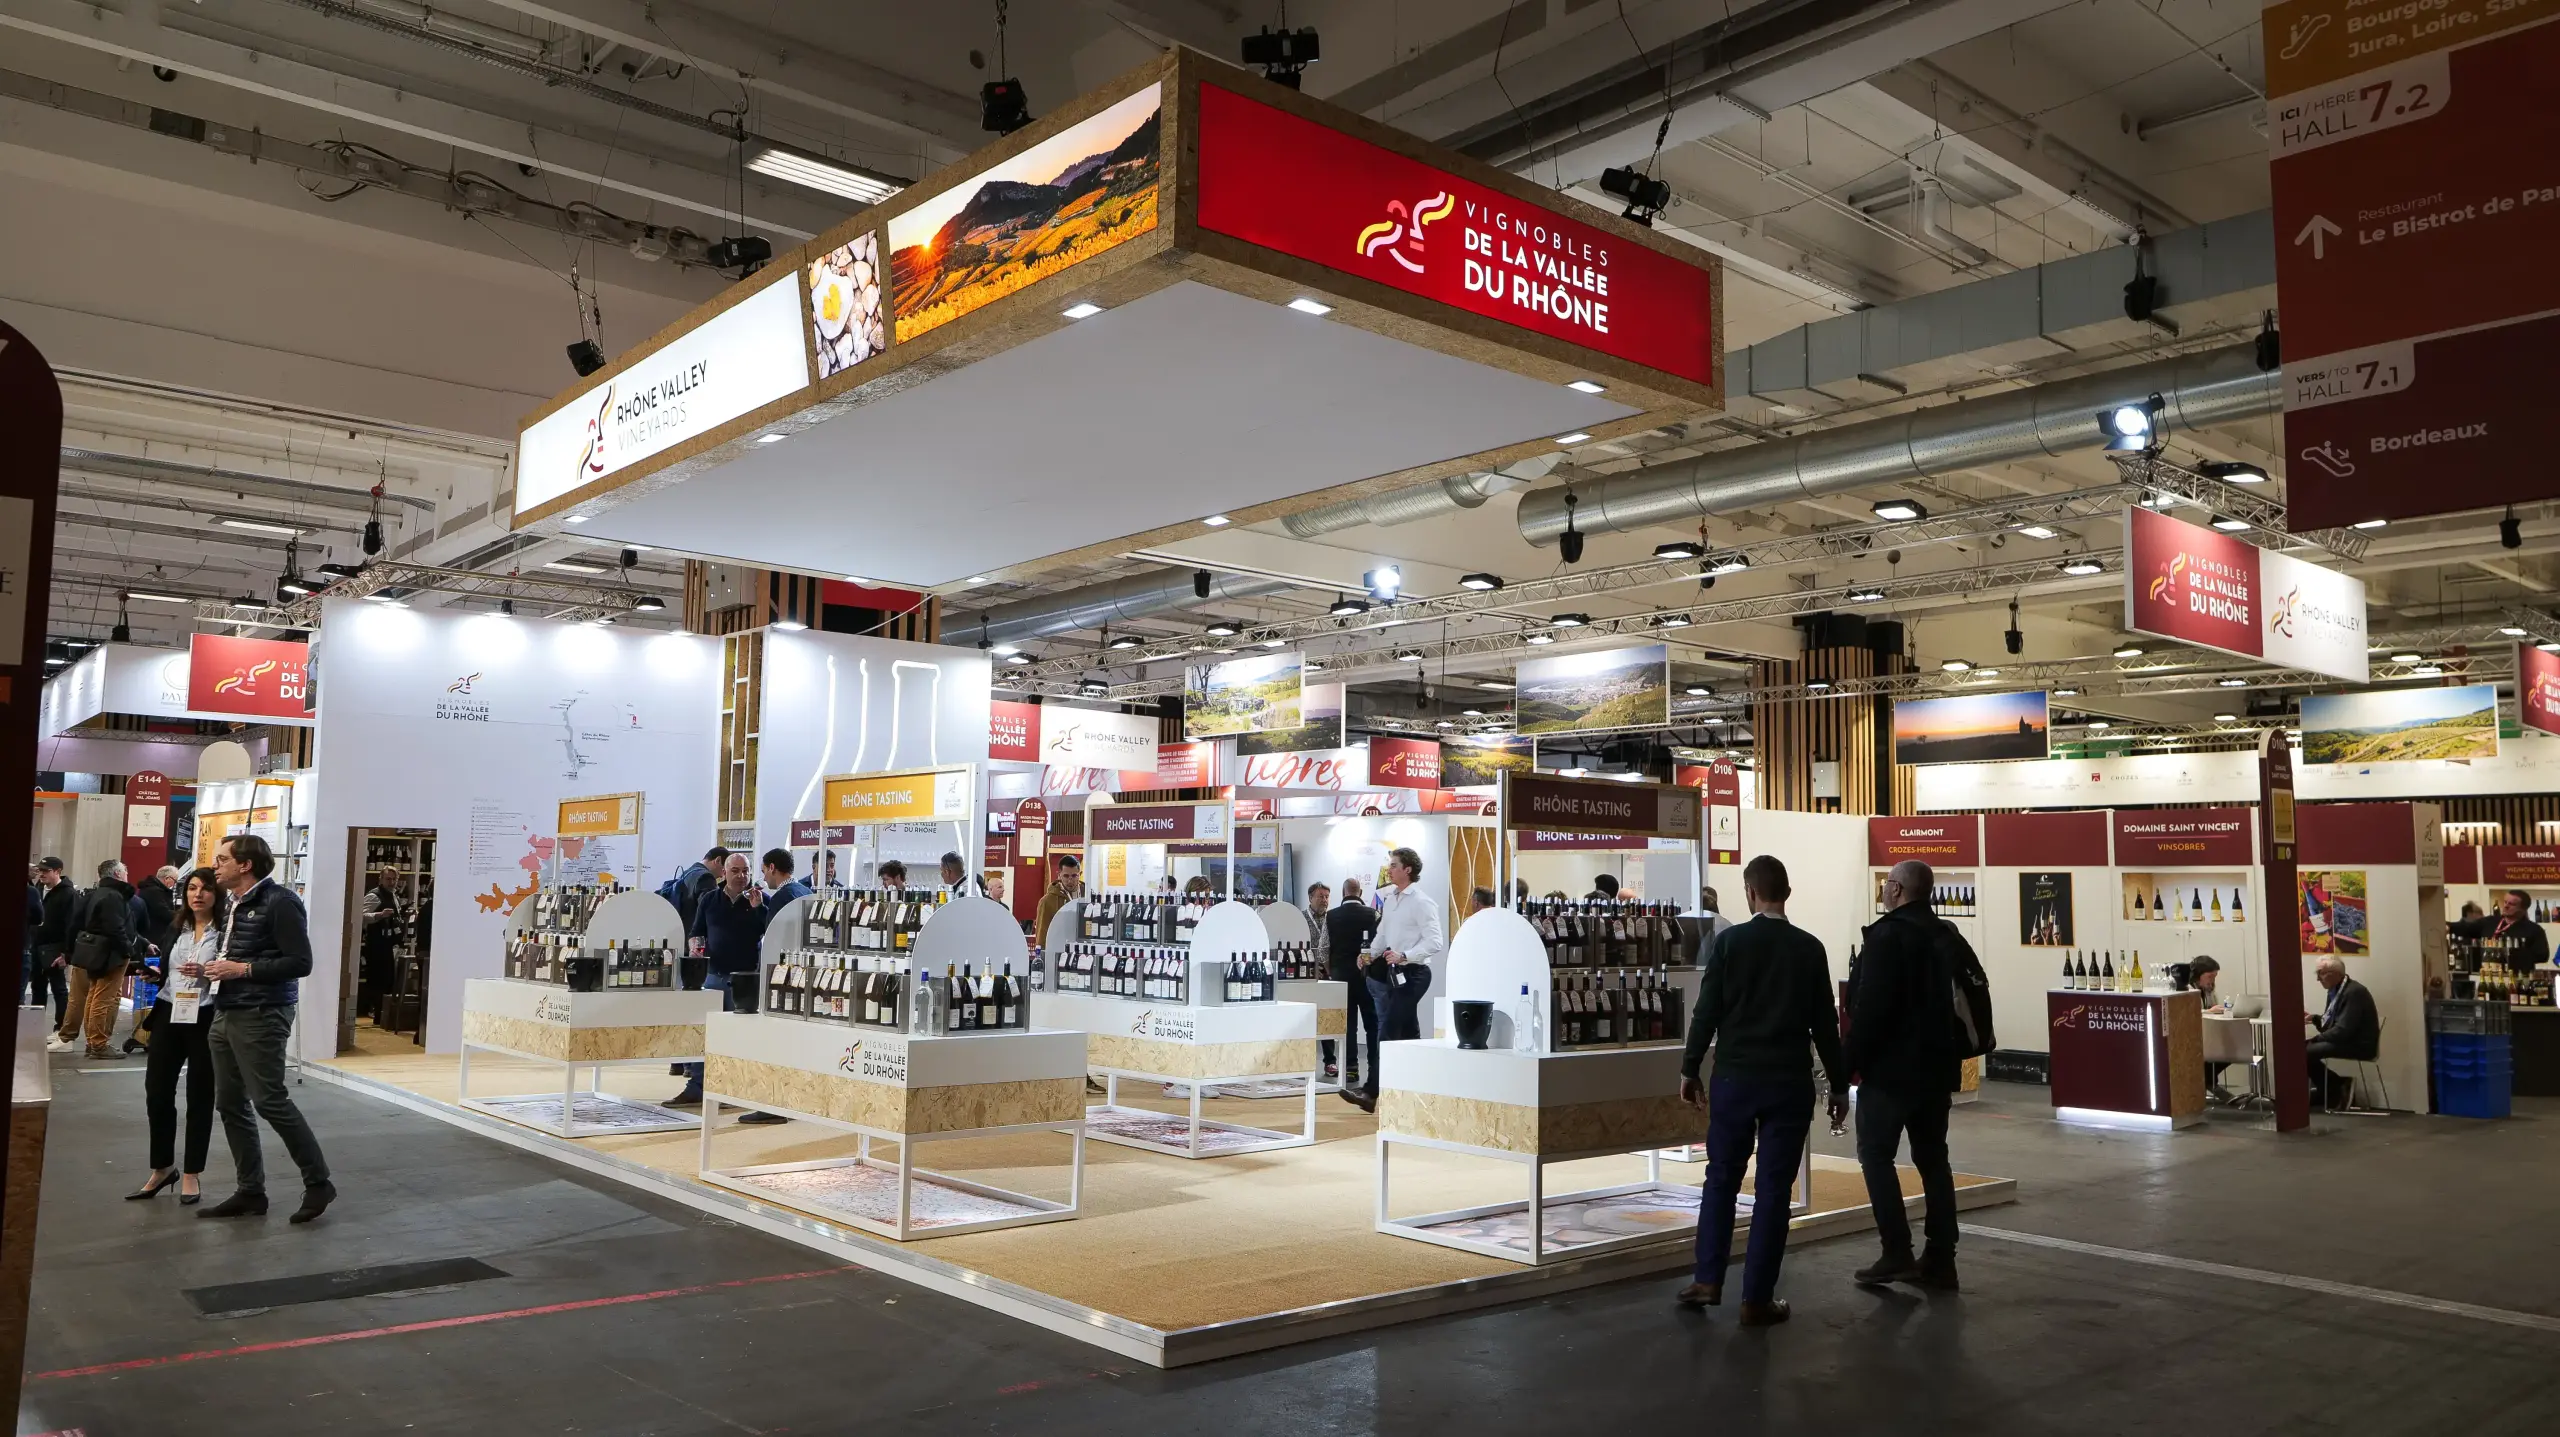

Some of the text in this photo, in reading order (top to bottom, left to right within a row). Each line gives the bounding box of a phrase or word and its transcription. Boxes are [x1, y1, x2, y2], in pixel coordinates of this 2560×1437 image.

[2347, 9, 2479, 58] Jura, Loire,
[2280, 107, 2301, 122] ICI
[2313, 90, 2356, 112] HERE
[2281, 80, 2430, 148] HALL 7.2
[2357, 191, 2444, 223] Restaurant
[2358, 226, 2387, 246] Le
[2392, 202, 2477, 238] Bistrot
[2482, 196, 2516, 216] de
[1465, 200, 1609, 267] VIGNOBLES
[1464, 227, 1609, 297] DE LA VALLÉE
[1464, 258, 1609, 334] DU RHÔNE
[2296, 370, 2326, 385] VERS
[2334, 366, 2350, 378] TO
[2297, 360, 2399, 403] HALL 7.1
[617, 358, 707, 427] RHÔNE VALLEY
[617, 400, 687, 452] VINEYARDS
[2369, 421, 2488, 453] Bordeaux
[2188, 554, 2248, 582] VIGNOBLES
[2189, 571, 2248, 601] DE LA VALLÉE
[2190, 591, 2249, 626] DU RHÔNE
[2332, 612, 2361, 632] VALLEY
[281, 672, 299, 682] DE
[280, 685, 306, 699] DU
[437, 711, 489, 721] DU RHÔNE
[462, 705, 489, 713] VALLÉE
[994, 723, 1027, 735] VALLÉE
[1117, 735, 1150, 746] VALLEY
[2271, 739, 2287, 751] D106
[1406, 759, 1415, 767] DE
[1714, 763, 1733, 776] D106
[137, 775, 162, 783] E144
[1406, 767, 1418, 777] DU
[841, 789, 913, 808] RHÔNE TASTING
[1025, 801, 1042, 810] D138
[1533, 793, 1632, 817] RHÔNE TASTING
[568, 810, 587, 824] RHÔNE
[587, 810, 608, 823] TASTING
[1106, 817, 1174, 831] RHÔNE TASTING
[801, 827, 820, 839] RHÔNE
[915, 826, 937, 834] RHÔNE
[1899, 828, 1944, 836] CLAIRMONT
[2123, 822, 2240, 833] DOMAINE SAINT VINCENT
[1888, 845, 1957, 854] CROZES-HERMITAGE
[2157, 842, 2206, 851] VINSOBRES
[2505, 872, 2530, 880] VALLÉE
[548, 1011, 555, 1020] DU
[2088, 1005, 2145, 1013] VIGNOBLES
[1155, 1017, 1194, 1029] DE LA VALLÉE
[2113, 1012, 2144, 1021] VALLÉE
[2088, 1020, 2145, 1032] DU RHÔNE
[1154, 1026, 1194, 1041] DU RHÔNE
[864, 1040, 906, 1053] VIGNOBLES
[864, 1050, 906, 1066] DE LA VALLÉE
[863, 1062, 906, 1082] DU RHÔNE
